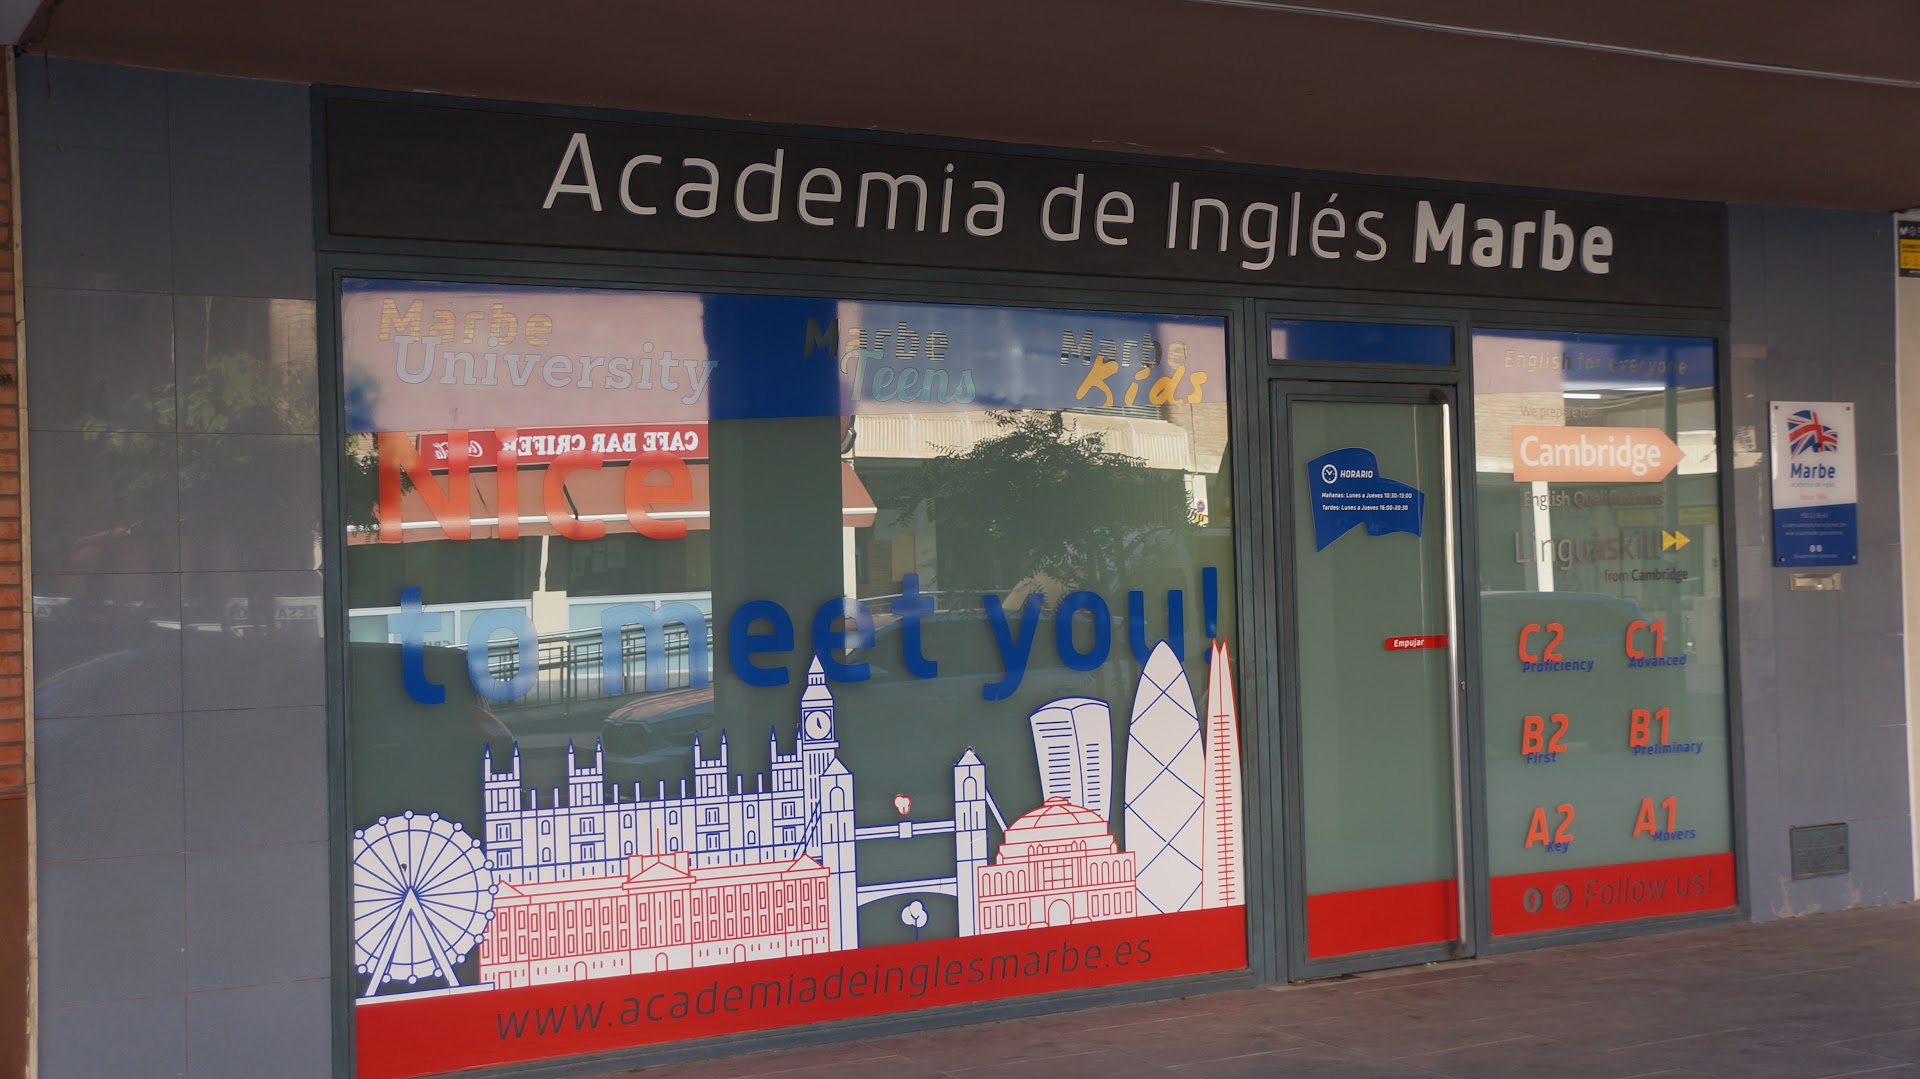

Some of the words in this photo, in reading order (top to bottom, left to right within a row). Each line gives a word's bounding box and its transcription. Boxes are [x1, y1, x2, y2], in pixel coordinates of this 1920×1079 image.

[542, 131, 1006, 237] Academia
[1041, 173, 1135, 246] de
[1166, 181, 1388, 271] Inglés
[1414, 200, 1614, 275] Marbe
[378, 298, 553, 346] Marbe
[803, 317, 948, 361] Marbe
[1060, 329, 1188, 369] Marbe
[1504, 350, 1570, 373] English
[1577, 351, 1602, 369] for
[1608, 357, 1688, 377] everyone
[394, 335, 718, 405] University
[840, 348, 976, 404] Teens
[1075, 355, 1208, 407] Kids
[1520, 405, 1538, 418] We
[1340, 470, 1373, 478] HORARIO
[1520, 435, 1661, 476] Cambridge
[1791, 463, 1835, 478] Marbe
[379, 427, 693, 541] Nice
[1523, 490, 1570, 510] English
[1515, 527, 1662, 570] Linguaskill
[1604, 570, 1628, 583] from
[1631, 569, 1688, 583] Cambridge
[388, 586, 539, 704] to
[601, 573, 938, 694] meet
[982, 567, 1218, 700] you!
[1394, 639, 1424, 648] Empujar
[1518, 622, 1564, 663] C2
[1625, 620, 1665, 659] C1
[1523, 659, 1594, 673] Proficiency
[1628, 654, 1686, 668] Advanced
[1521, 713, 1569, 755] B2
[1628, 707, 1670, 748] B1
[1526, 751, 1557, 764] First
[1634, 740, 1703, 756] Preliminary
[1524, 803, 1575, 849] A2
[1633, 796, 1677, 837] A1
[1653, 829, 1696, 842] Movers
[1547, 840, 1569, 853] Key
[1585, 875, 1669, 908] Follow
[1675, 868, 1713, 898] us!
[496, 936, 1152, 1040] www.academiadeinglesmarbe.es
